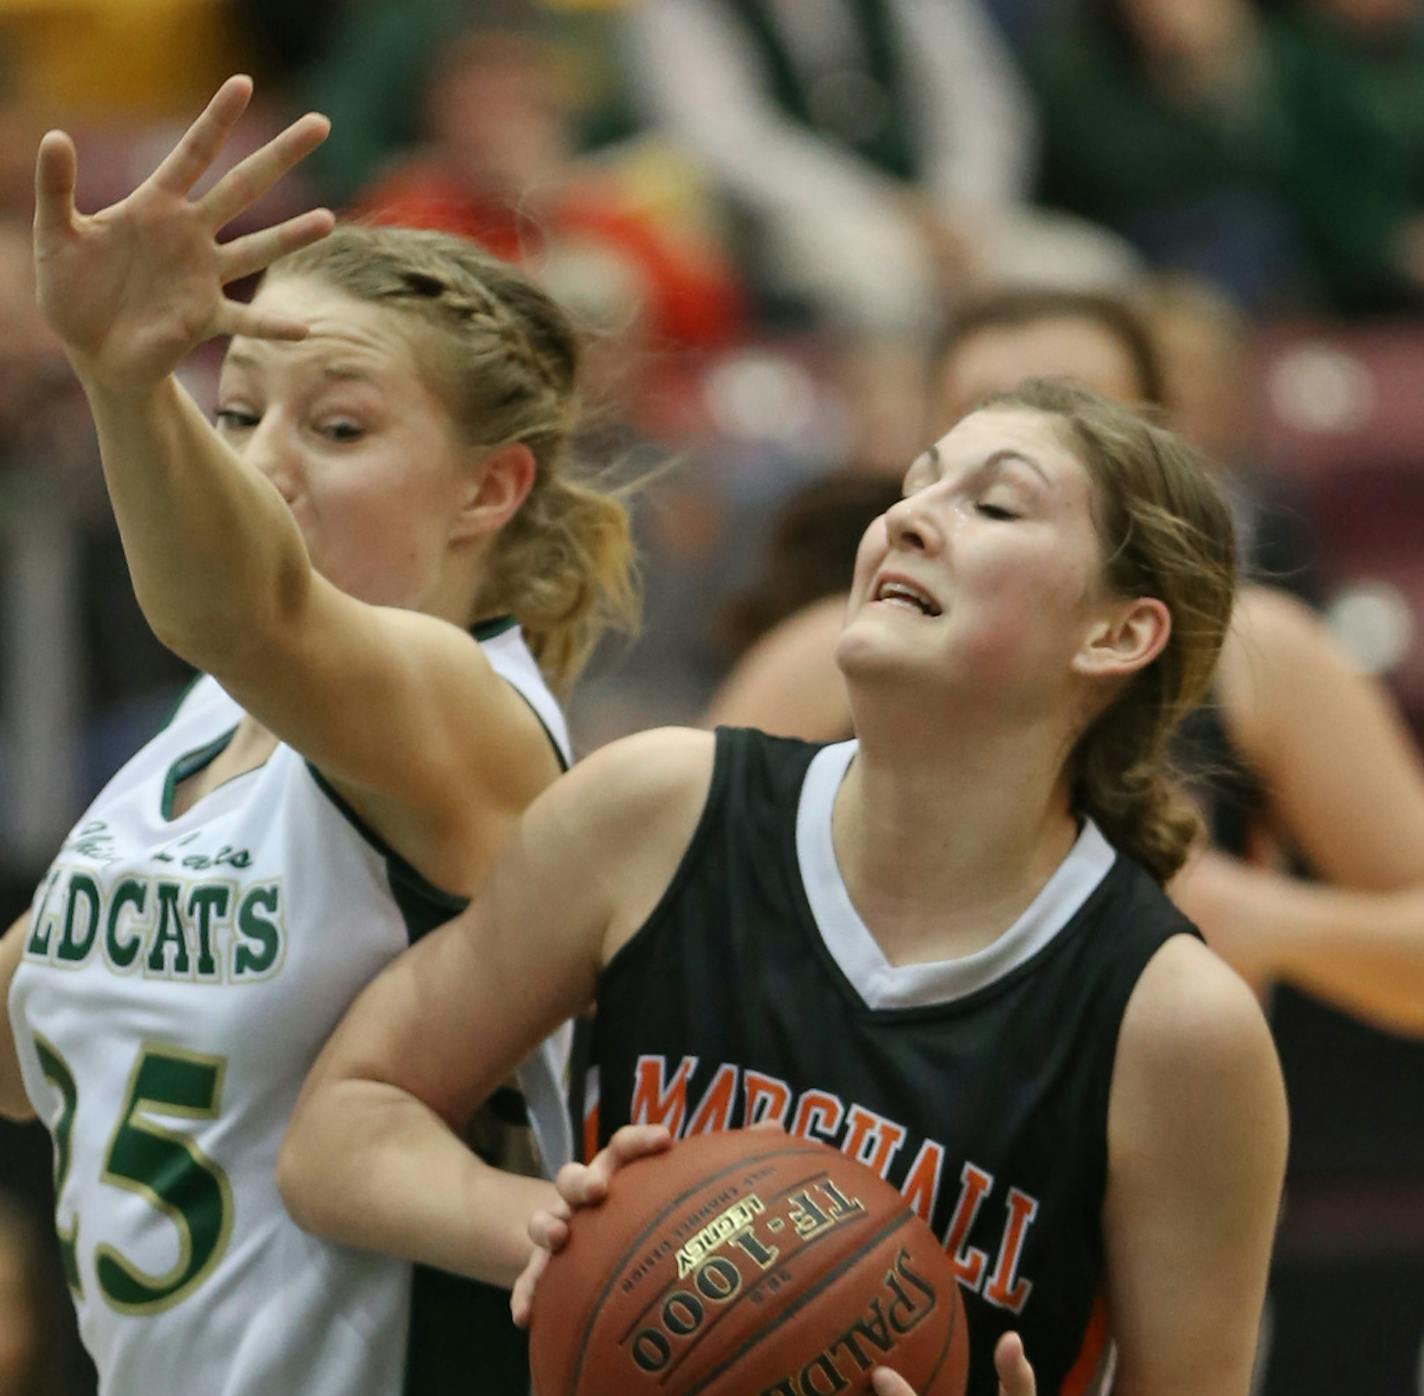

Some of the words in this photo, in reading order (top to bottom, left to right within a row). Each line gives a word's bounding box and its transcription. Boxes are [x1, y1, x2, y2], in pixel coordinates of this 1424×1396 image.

[621, 1240, 672, 1295] DESIGN
[630, 1177, 866, 1375] TF-1000
[675, 1193, 766, 1280] LEGACY
